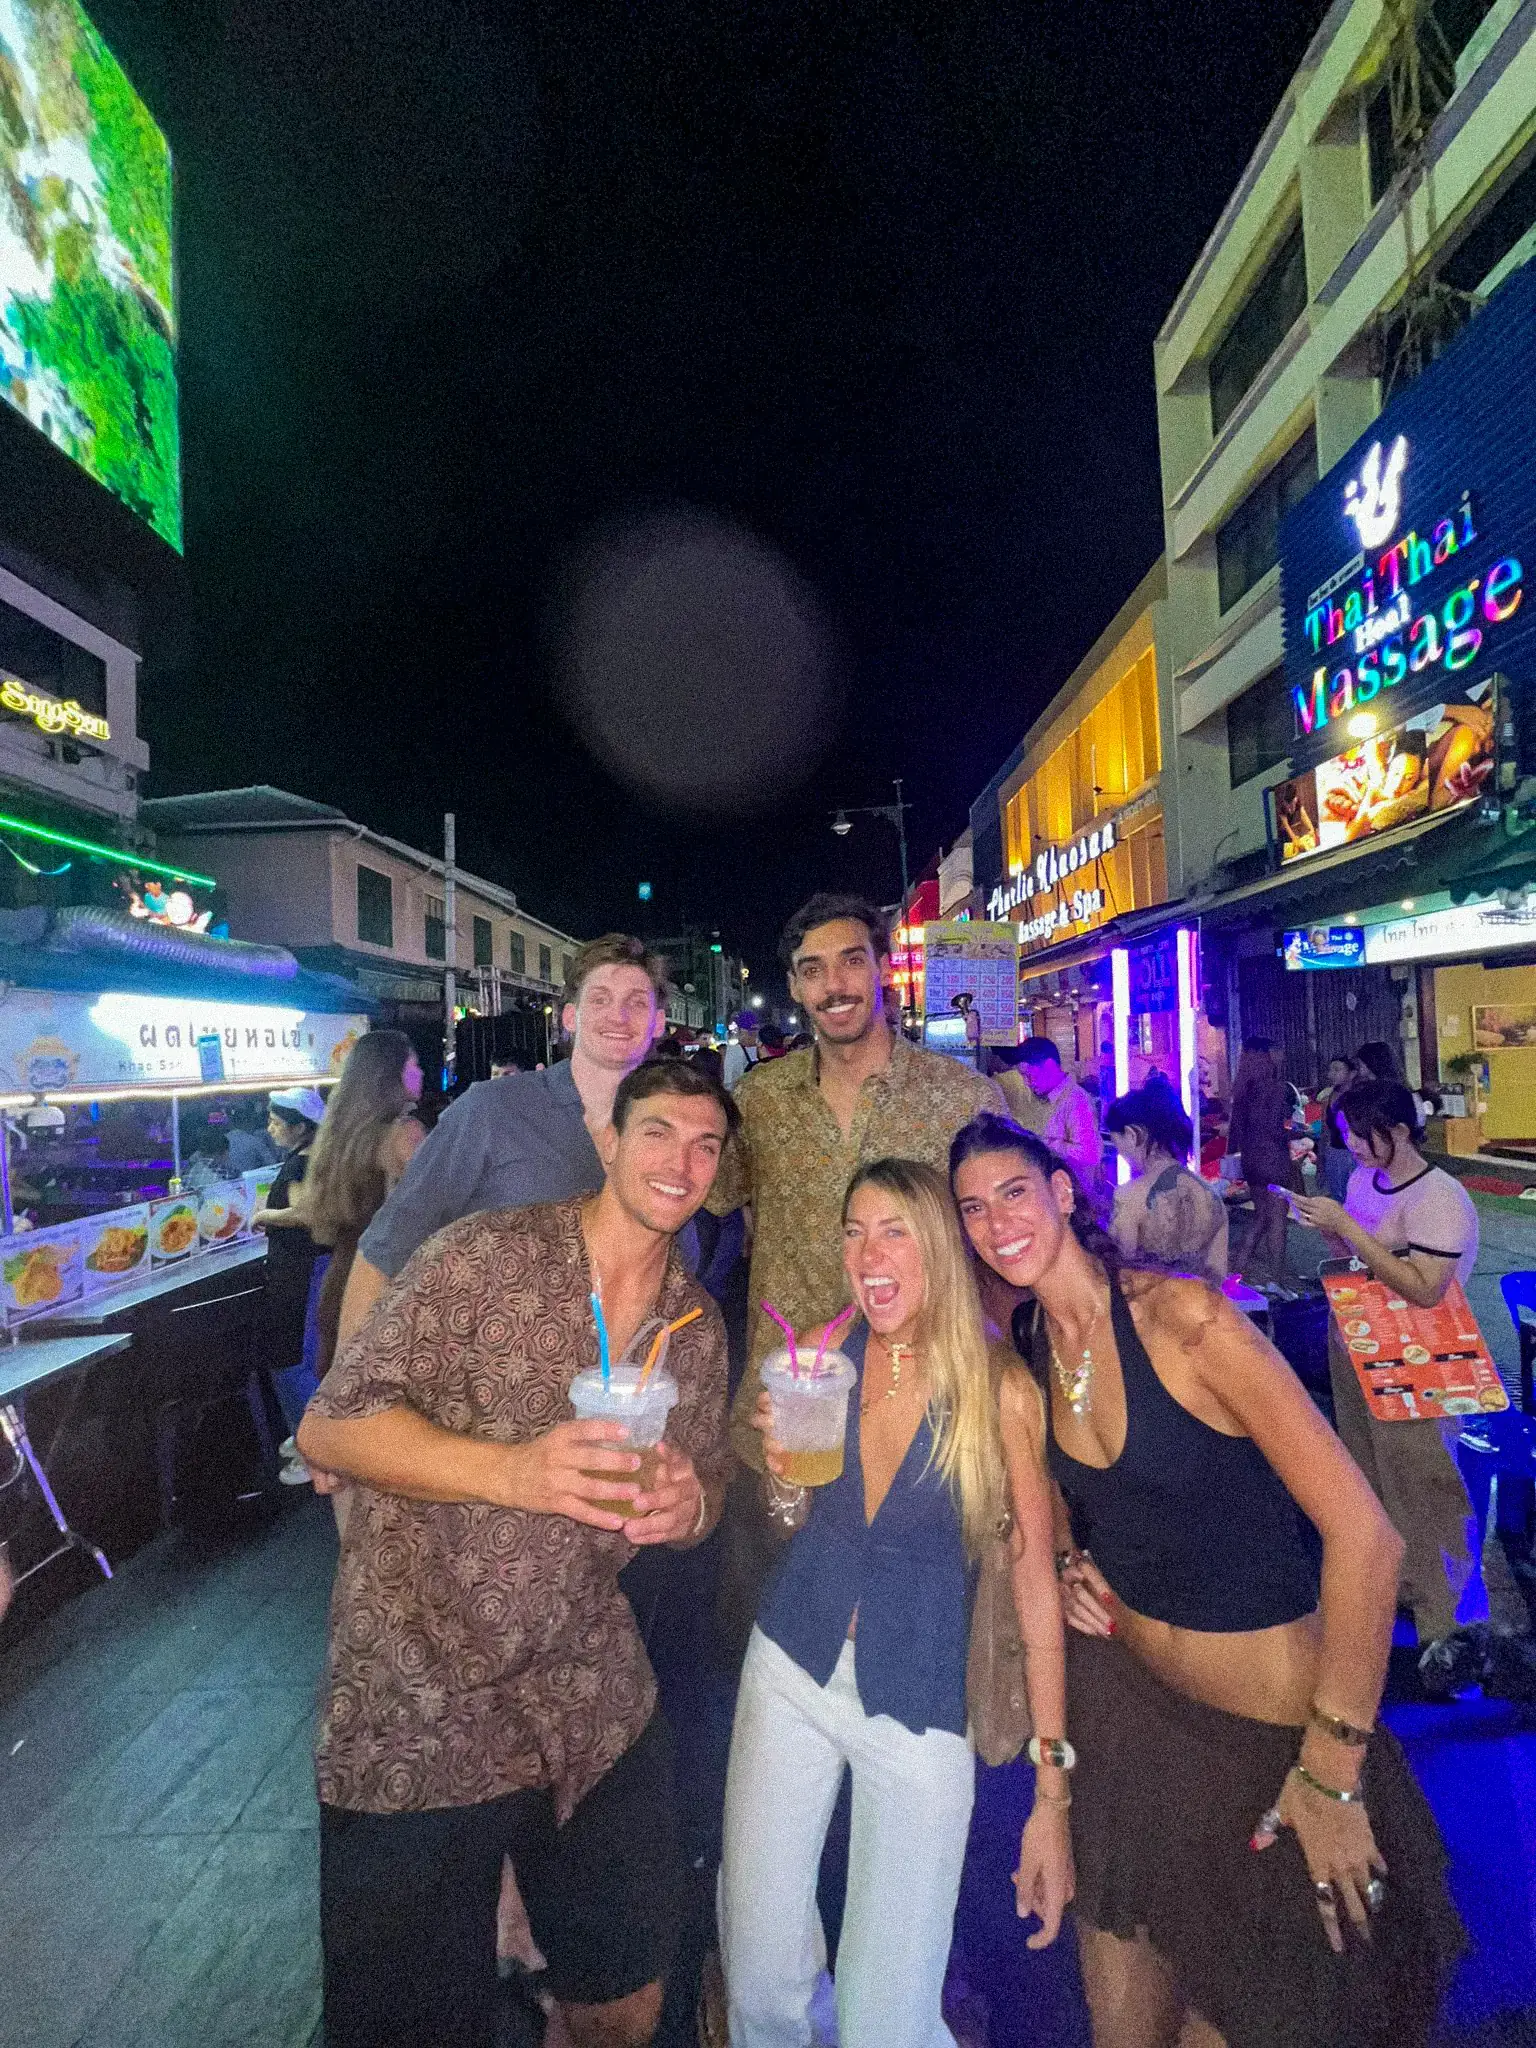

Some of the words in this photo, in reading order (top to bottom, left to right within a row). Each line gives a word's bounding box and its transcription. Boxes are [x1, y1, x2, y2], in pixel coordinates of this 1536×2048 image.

[1290, 557, 1523, 741] Massage
[1305, 567, 1379, 655] Thai
[1378, 489, 1477, 601] Thai
[1073, 888, 1102, 923] Spa
